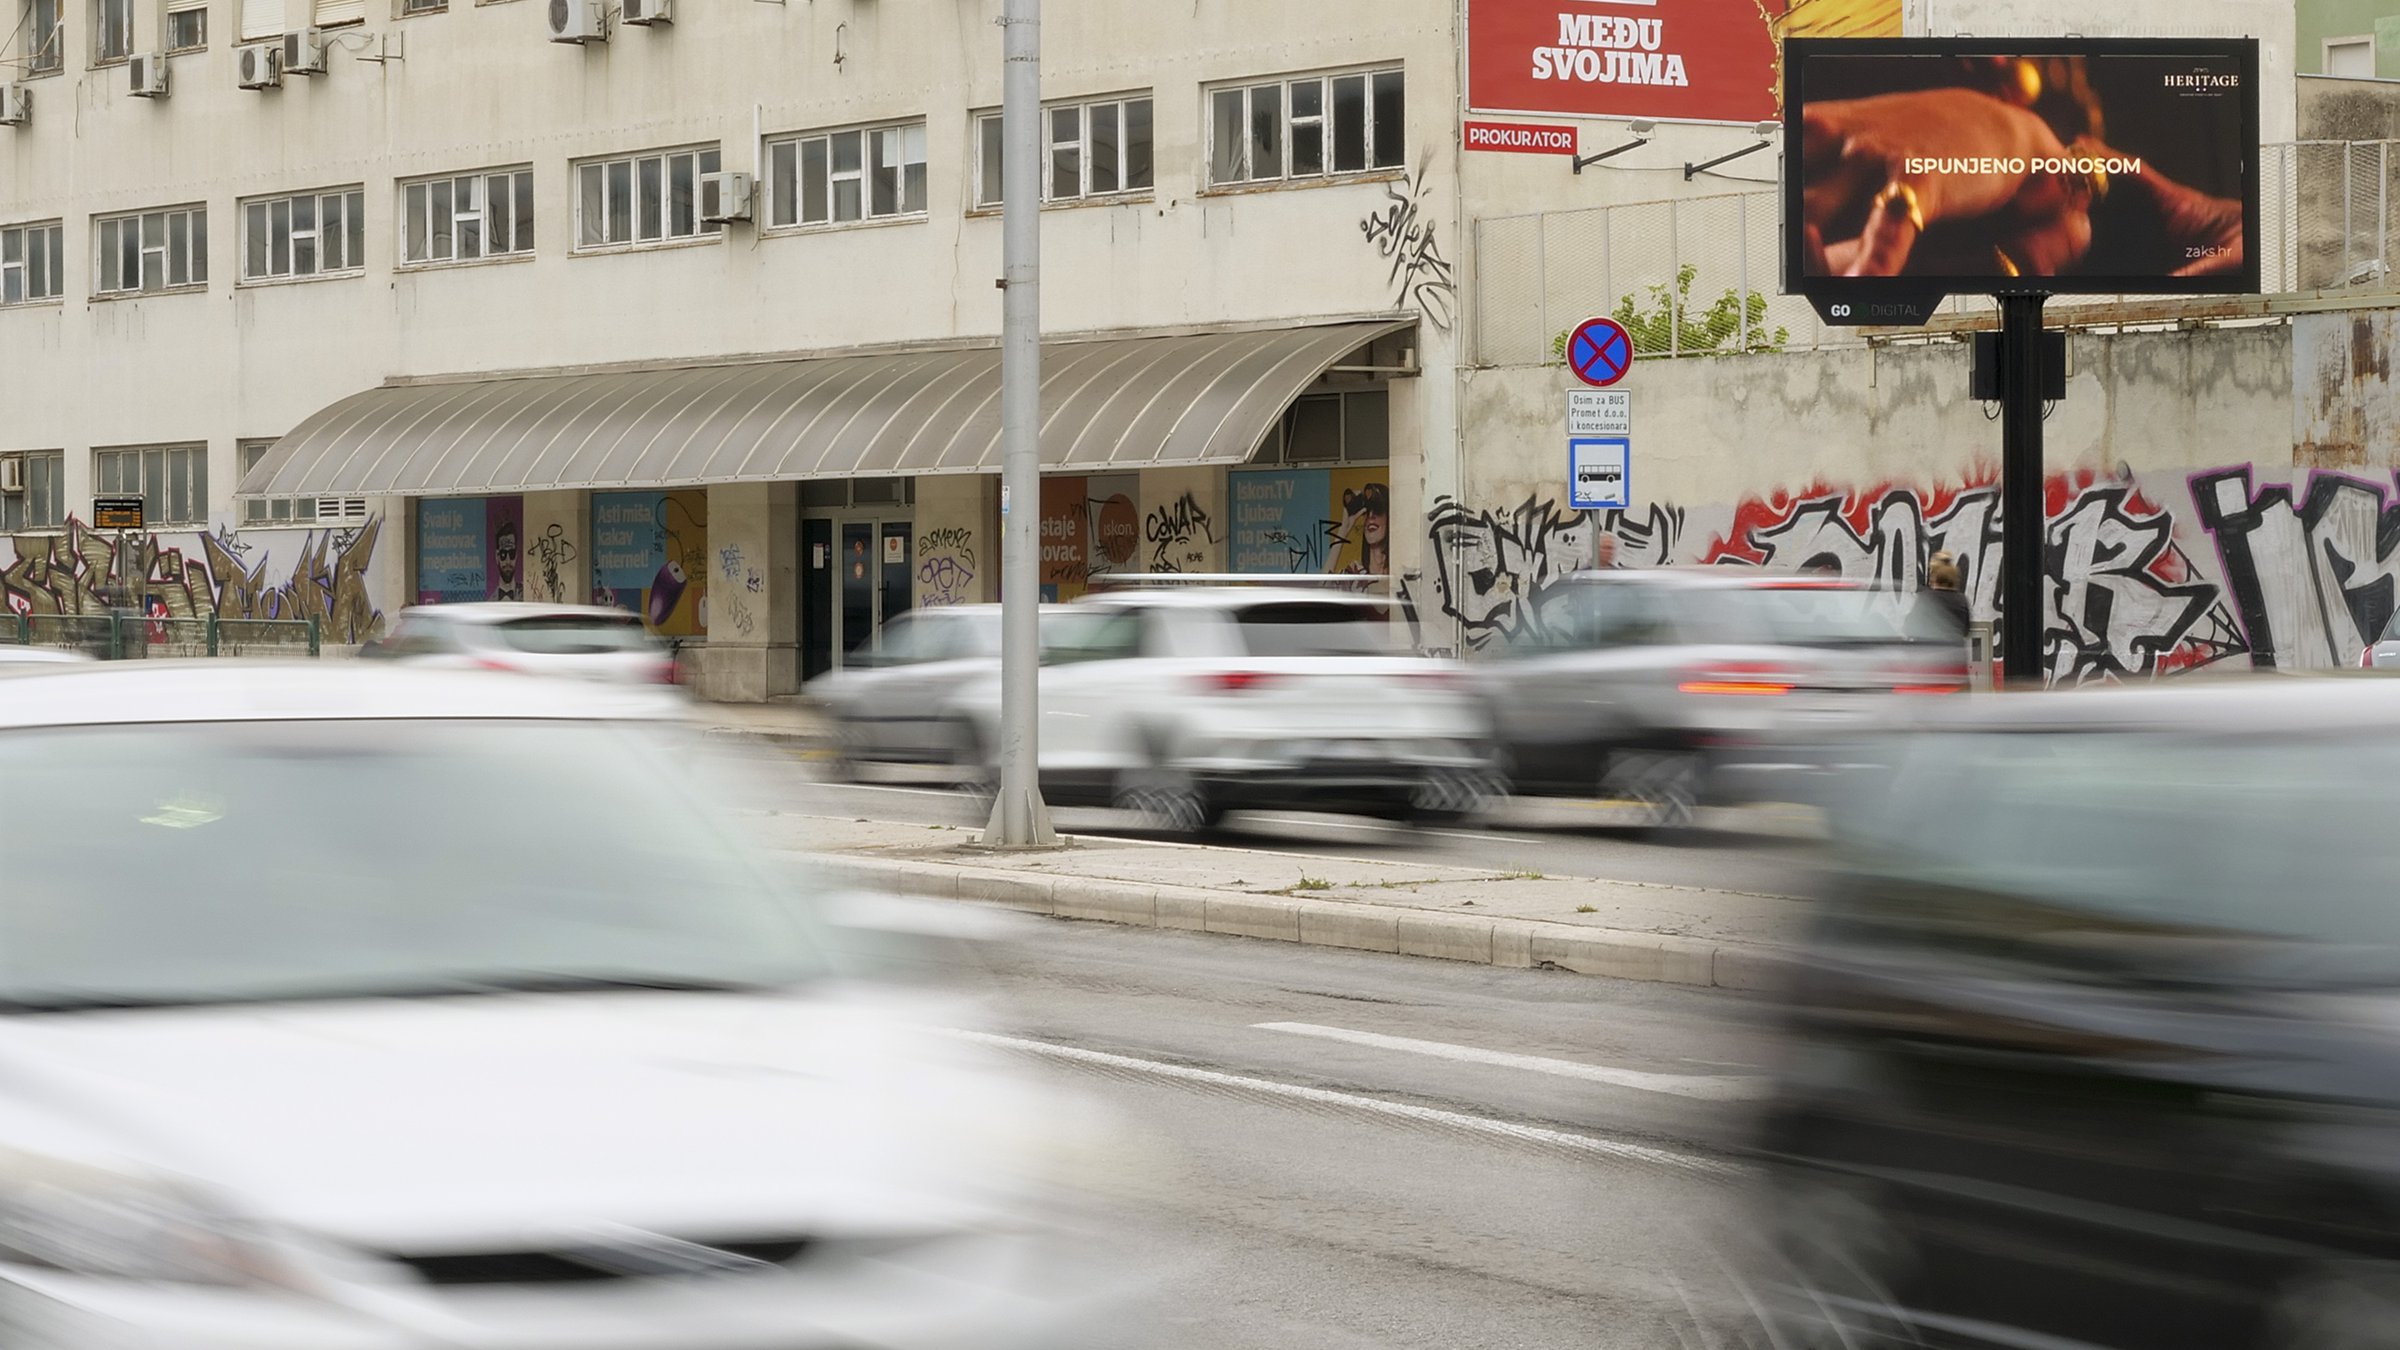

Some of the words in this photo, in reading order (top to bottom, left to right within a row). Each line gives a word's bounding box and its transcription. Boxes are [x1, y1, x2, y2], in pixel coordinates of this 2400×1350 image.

[1558, 13, 1663, 51] MEĐU
[1532, 46, 1689, 87] SVOJIMA
[2164, 74, 2239, 87] HERITAGE
[1469, 127, 1572, 149] PROKURATOR
[1904, 157, 2026, 175] ISPUNJENO
[2031, 157, 2141, 175] PONOSOM
[2185, 244, 2233, 258] zaks.hr
[1830, 304, 1851, 317] GO
[1871, 304, 1920, 317] DIGITAL
[1573, 395, 1593, 405] Osim
[1596, 397, 1606, 405] za
[1608, 395, 1625, 405] BUS
[1571, 408, 1601, 418] Promet
[1604, 408, 1627, 418] d.o.o.
[1576, 421, 1628, 430] koncesionara
[1237, 479, 1295, 500] Iskon.TV
[424, 511, 450, 529] Svaki
[451, 510, 464, 531] je
[597, 504, 620, 524] Asti
[1236, 503, 1284, 526] Ljubav
[597, 527, 634, 547] kakav
[1040, 515, 1076, 540] staje
[1103, 520, 1135, 536] iskon.
[423, 531, 477, 549] Iskonovac
[1236, 530, 1253, 545] na
[423, 552, 482, 573] megabitan.
